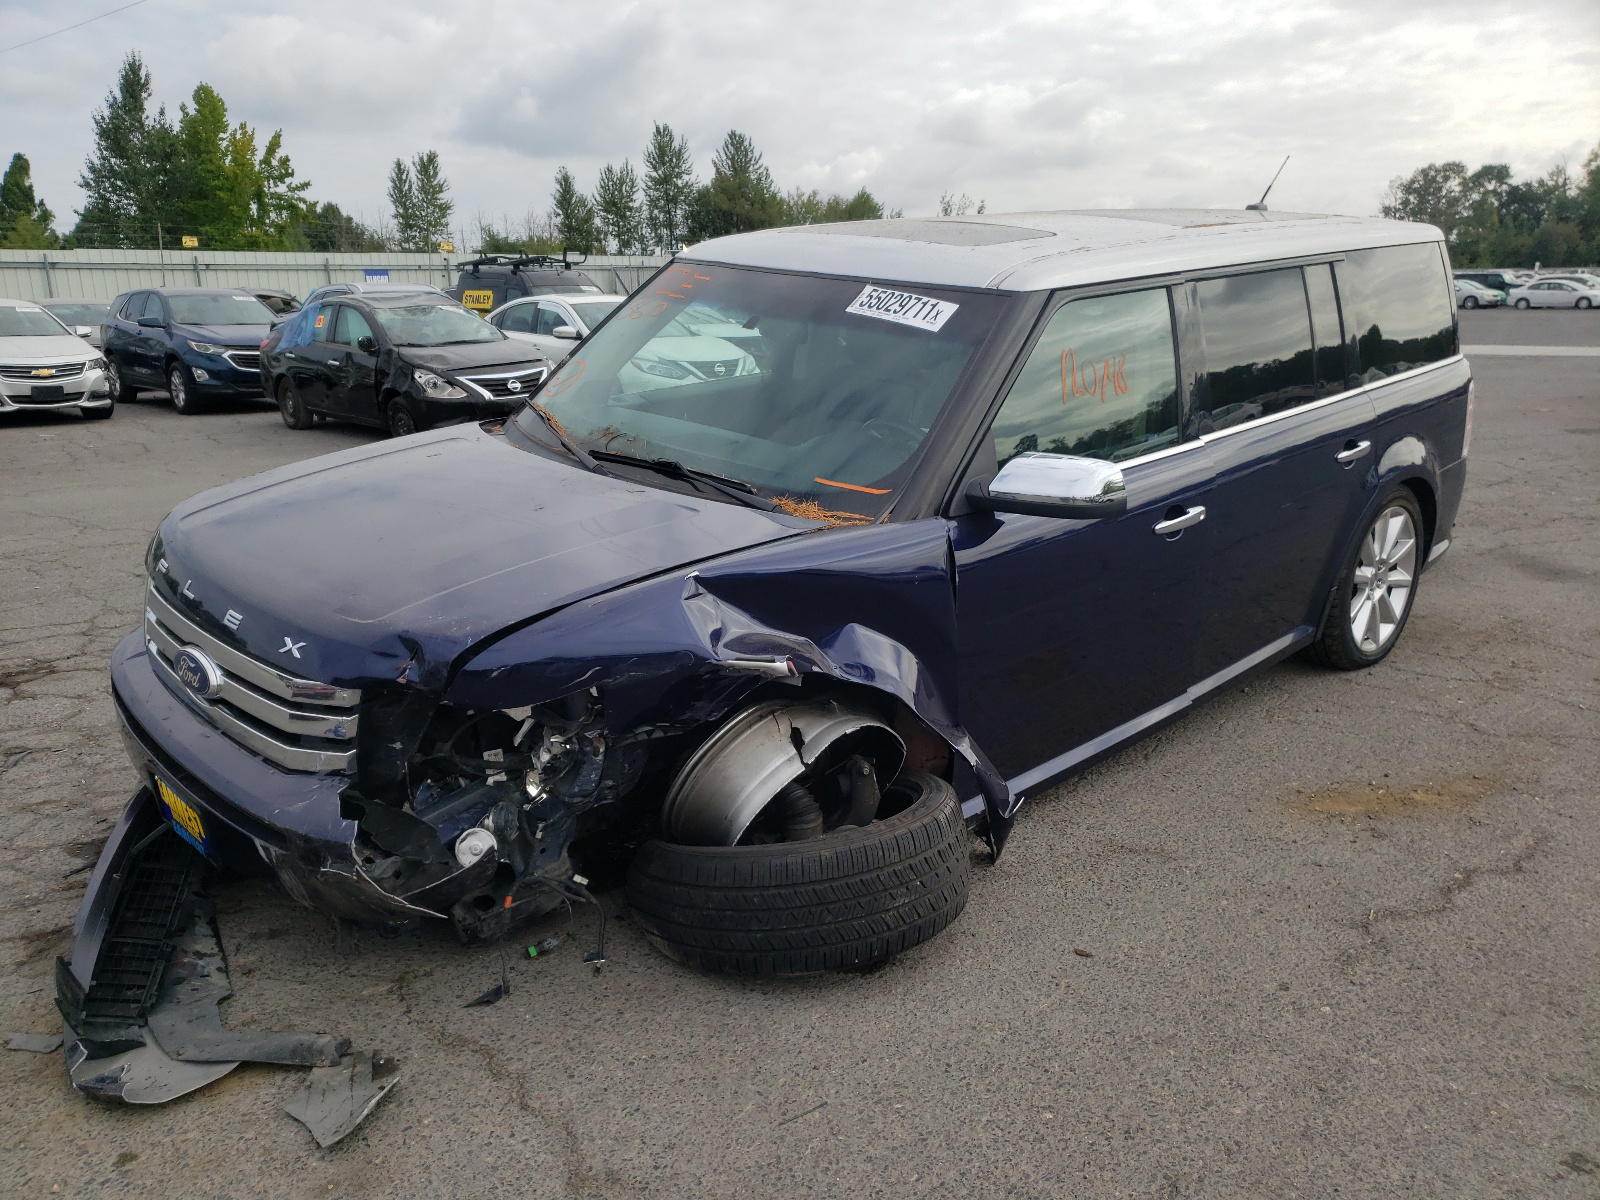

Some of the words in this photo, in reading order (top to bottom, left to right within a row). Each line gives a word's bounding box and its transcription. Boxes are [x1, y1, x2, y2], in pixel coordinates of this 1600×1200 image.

[464, 294, 491, 305] STANLEY
[155, 558, 307, 659] FLEX
[177, 655, 200, 688] Ford
